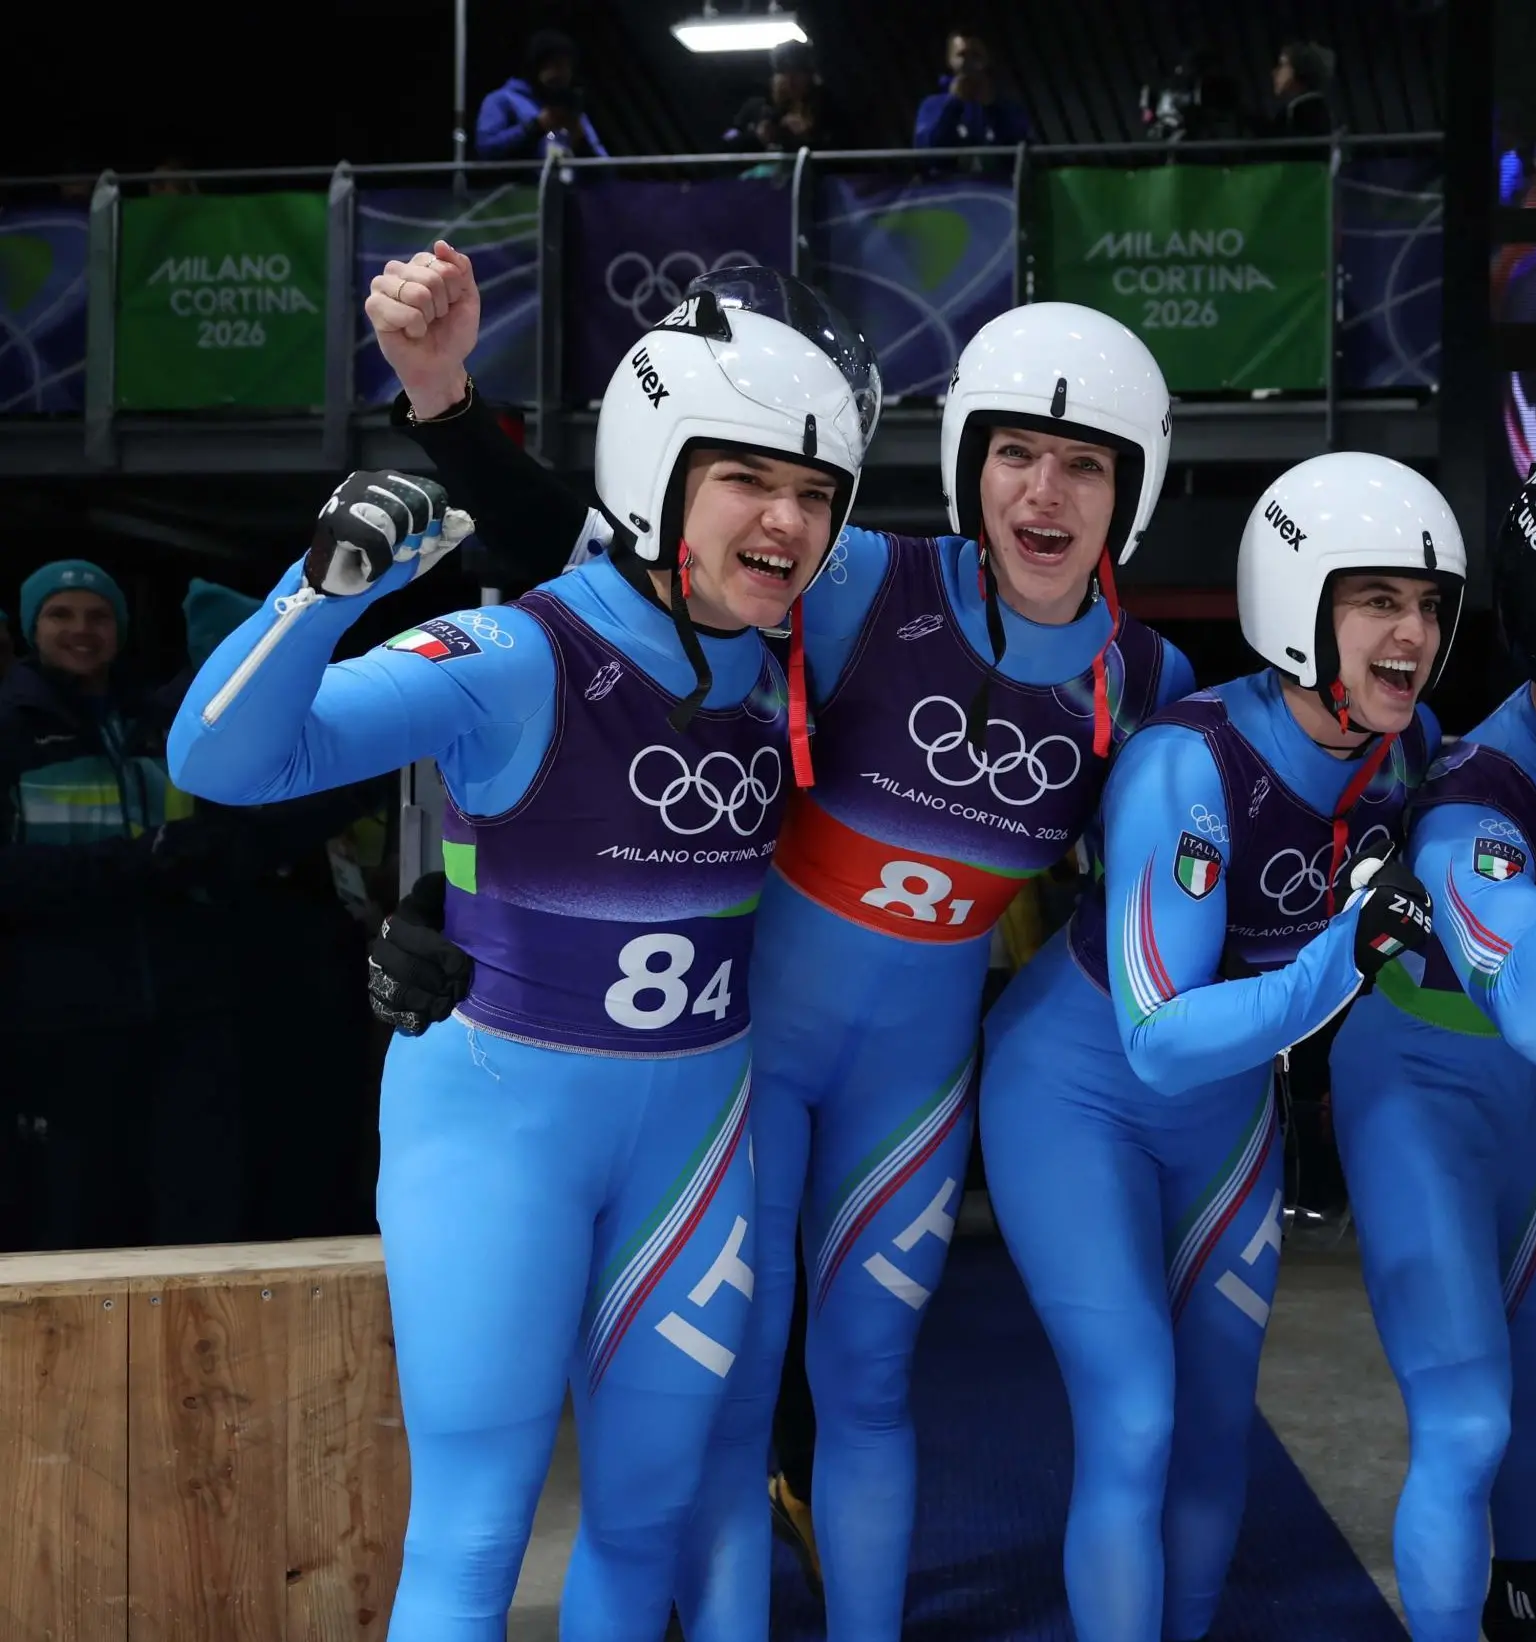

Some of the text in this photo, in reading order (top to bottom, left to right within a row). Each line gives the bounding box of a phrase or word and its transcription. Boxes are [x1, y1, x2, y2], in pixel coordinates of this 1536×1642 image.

[1085, 228, 1245, 262] MILANO
[147, 253, 292, 286] MILANO
[1112, 263, 1277, 296] CORTINA
[170, 286, 319, 317] CORTINA
[1142, 299, 1219, 329] 2026
[197, 320, 267, 348] 2026
[631, 347, 670, 409] uvex
[1265, 500, 1307, 552] uvex
[860, 772, 1069, 840] MILANO CORTINA 2026
[596, 845, 689, 863] MILANO
[693, 847, 759, 864] CORTINA
[1184, 837, 1221, 860] ITALIA
[1479, 840, 1523, 861] ITALIA
[1296, 919, 1329, 933] COR
[604, 933, 733, 1030] 84
[654, 1215, 755, 1379] IT
